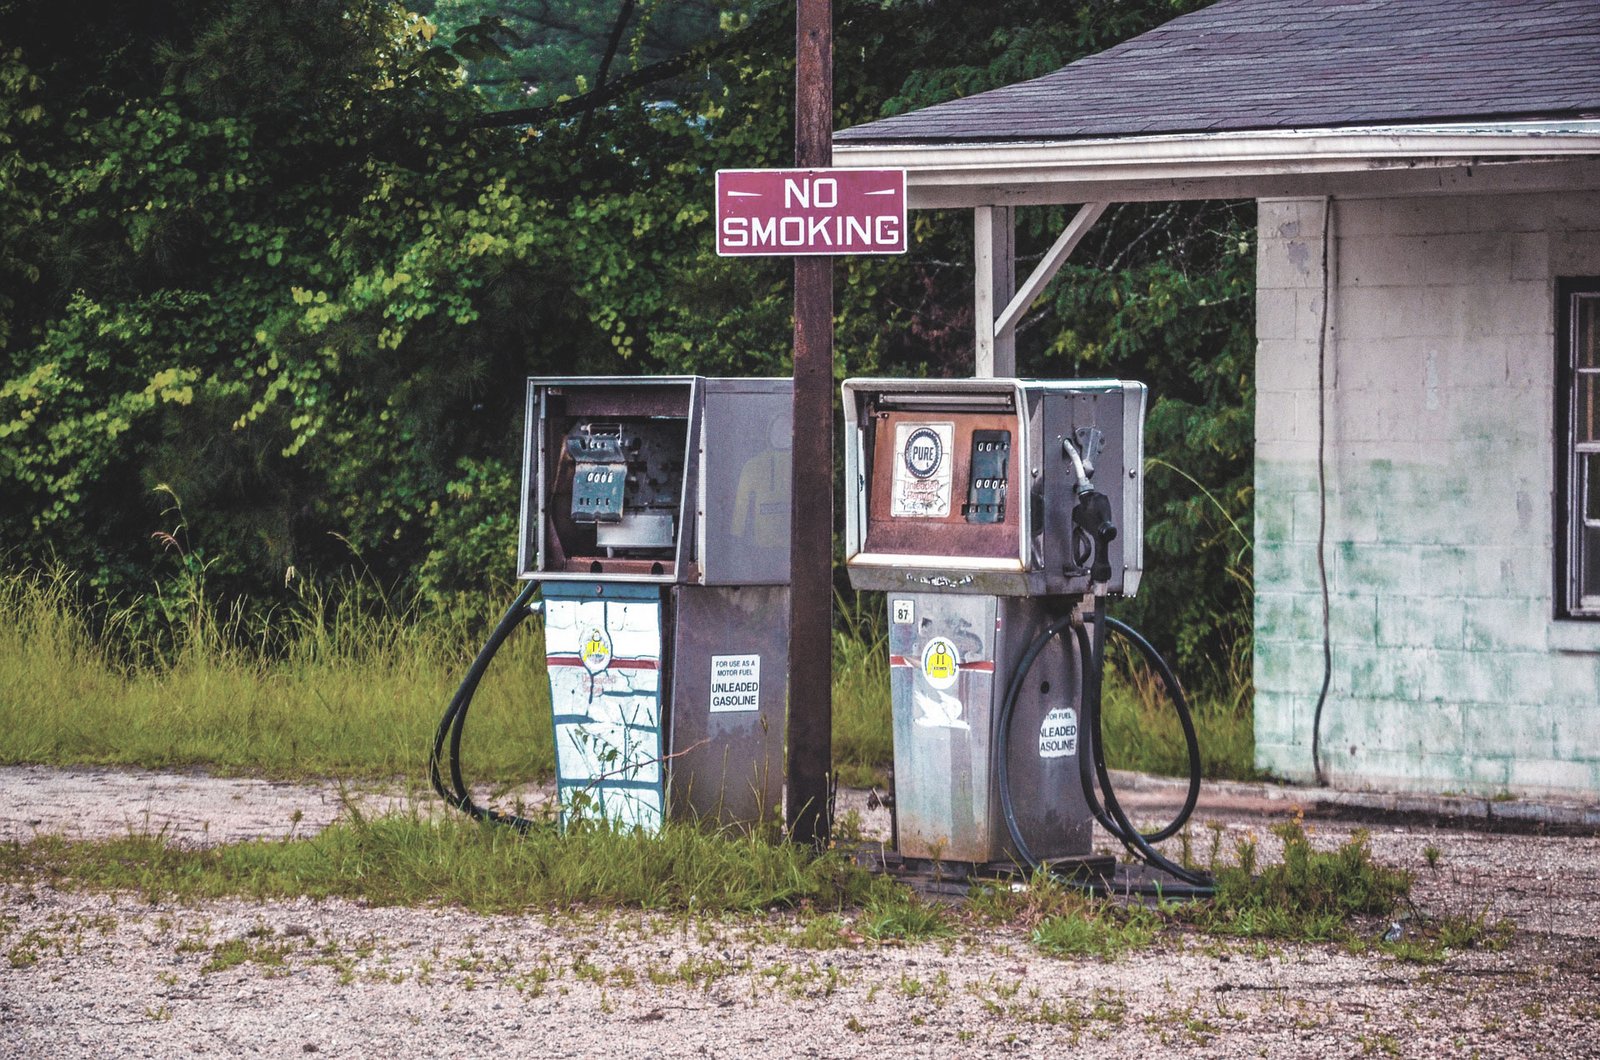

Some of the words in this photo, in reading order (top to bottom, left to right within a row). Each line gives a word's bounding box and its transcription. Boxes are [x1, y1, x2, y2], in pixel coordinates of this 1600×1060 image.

[784, 178, 838, 209] NO
[723, 215, 900, 247] SMOKING
[912, 446, 934, 461] PURE
[897, 608, 909, 620] 87
[711, 682, 759, 693] UNLEADED
[712, 695, 757, 706] GASOLINE
[1058, 712, 1072, 720] FUEL
[1040, 725, 1077, 738] NLEADED
[1040, 740, 1075, 752] ASOLINE
